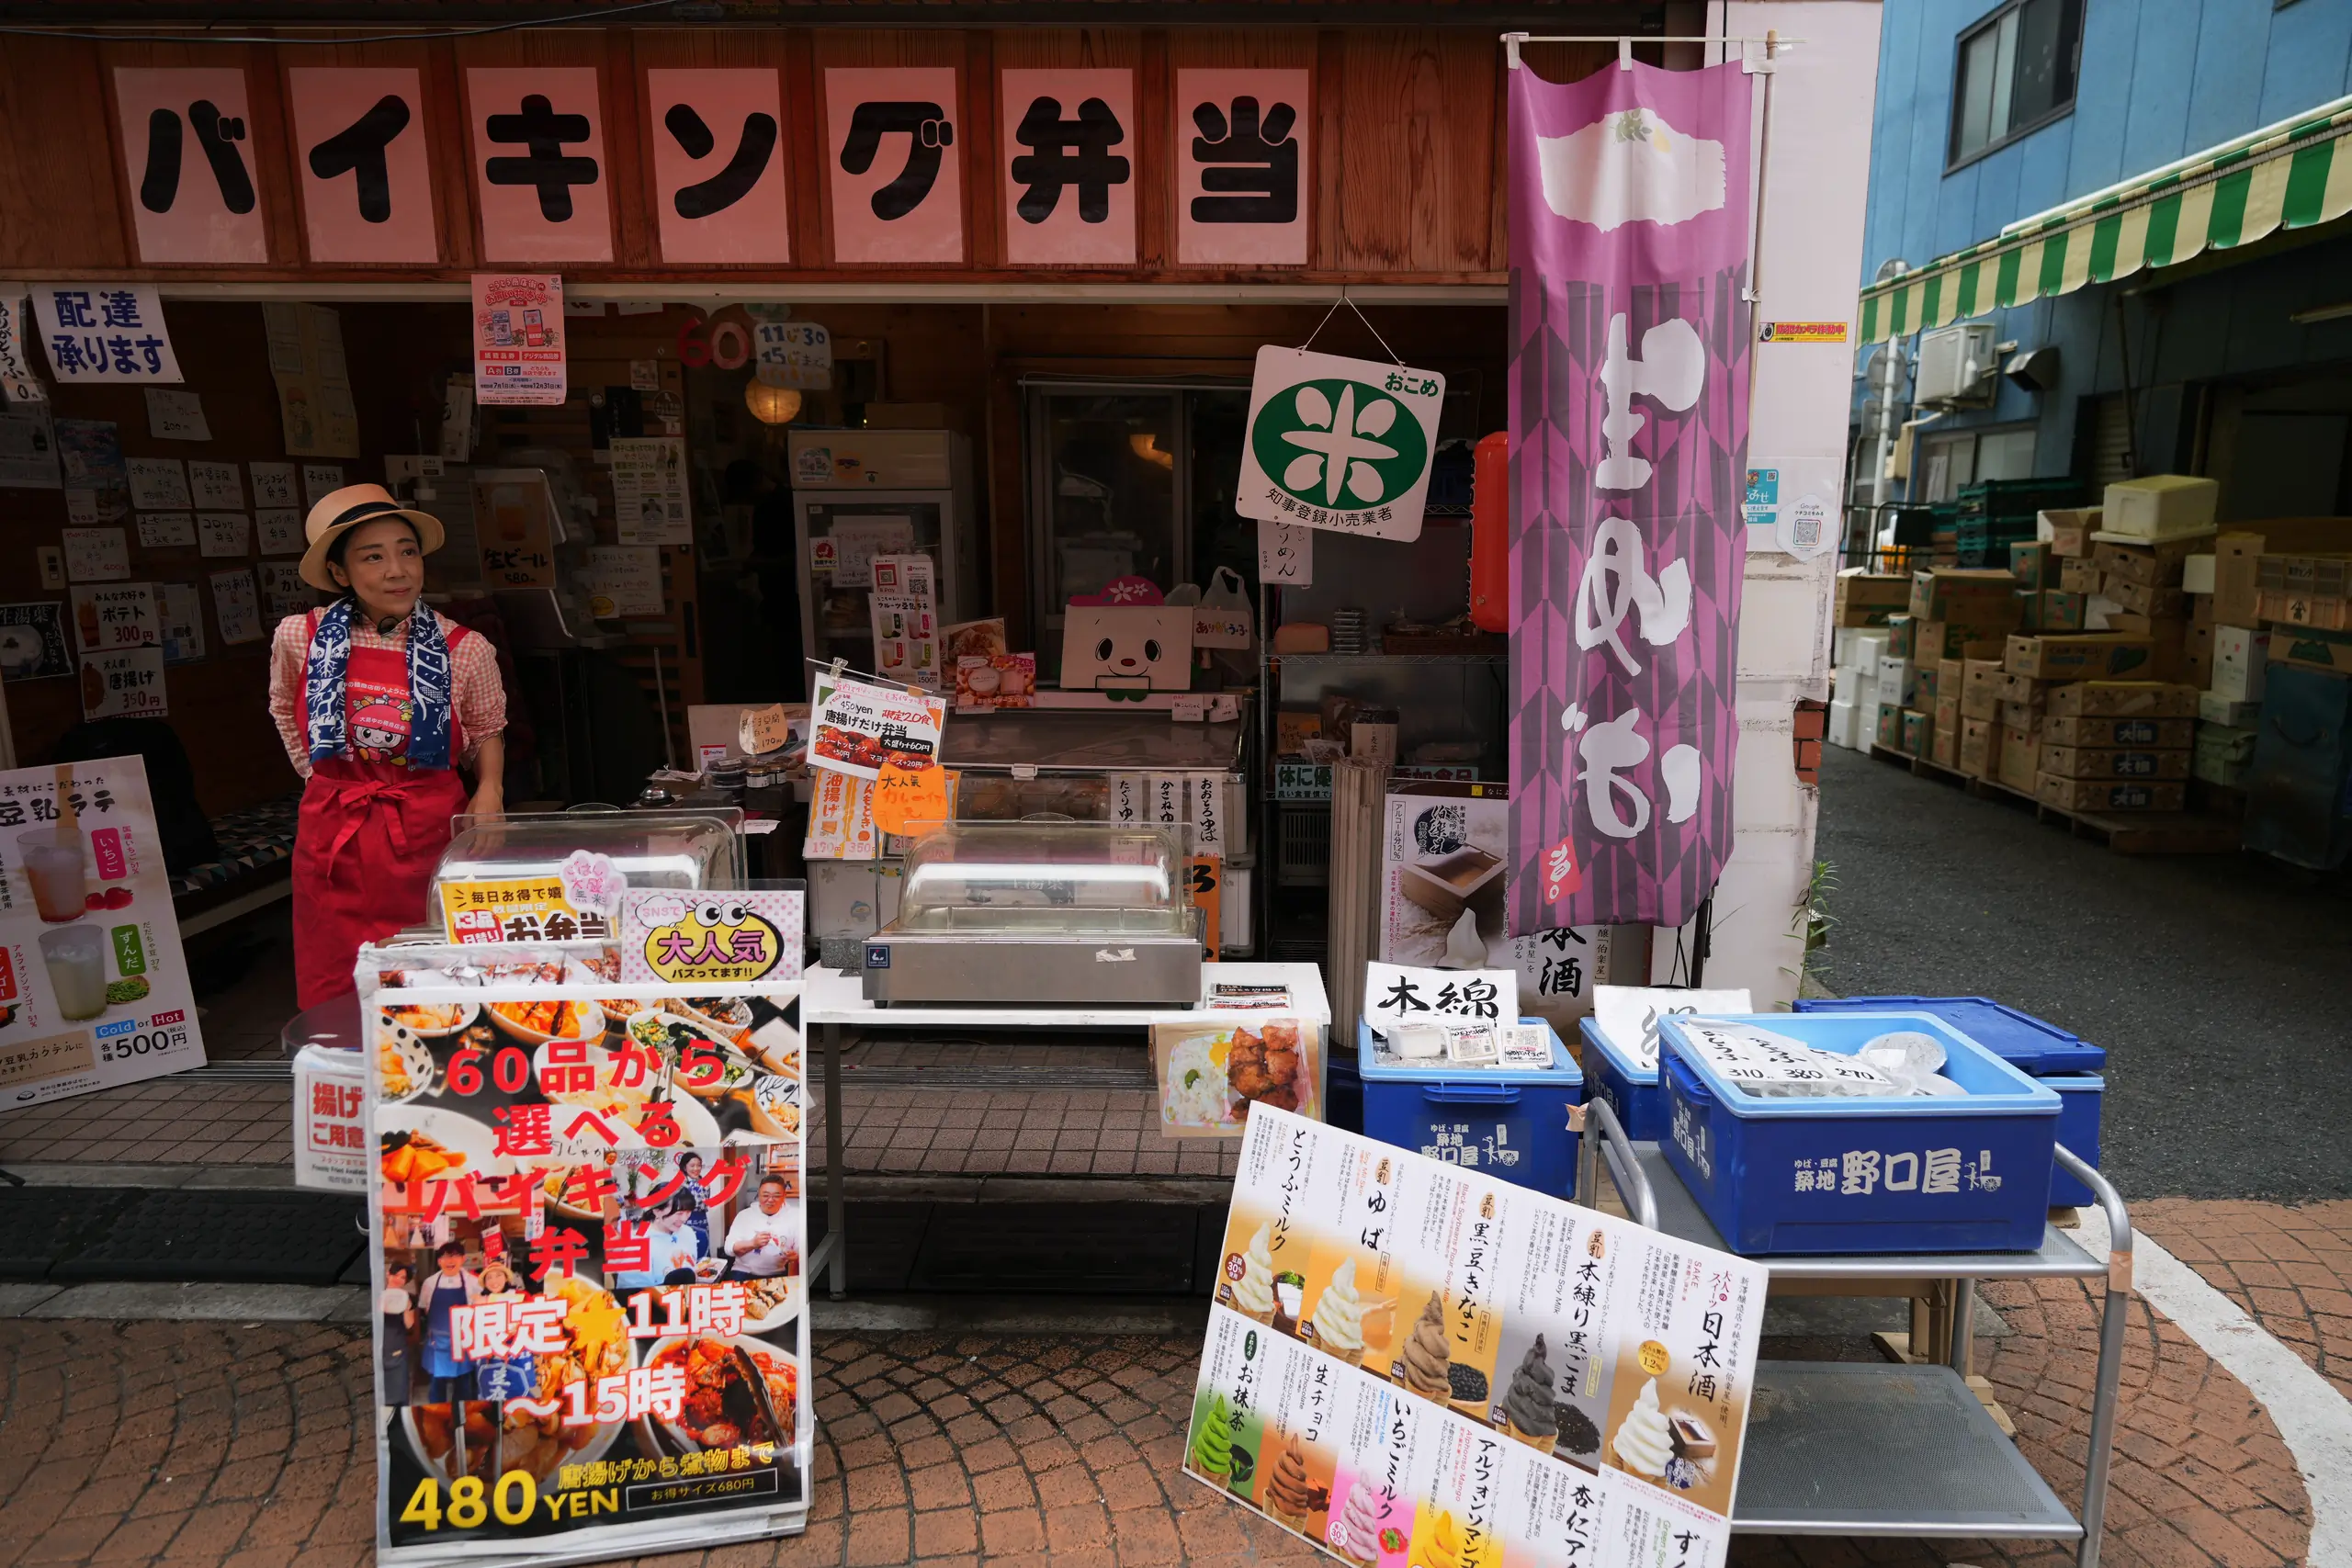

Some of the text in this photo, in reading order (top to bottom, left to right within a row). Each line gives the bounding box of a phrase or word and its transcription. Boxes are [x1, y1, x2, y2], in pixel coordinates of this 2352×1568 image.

[141, 94, 1298, 224] バイキング弁当
[53, 291, 142, 328] 配達
[1776, 324, 1845, 335] 防犯カメラ作動中
[52, 334, 164, 374] 承ります
[1385, 372, 1439, 398] おこめ
[1265, 487, 1394, 527] 知事登録小売業者
[103, 606, 145, 623] ポテト
[115, 626, 154, 643] 300円
[109, 671, 156, 689] 唐揚げ
[824, 710, 908, 737] 唐揚げだけ弁当
[819, 735, 867, 752] カレートッピング
[832, 749, 850, 758] +50円
[883, 739, 930, 751] 大盛り+60円
[870, 754, 923, 769] マヨネーズ+20円
[4, 777, 104, 797] 素材にこだわった
[823, 773, 842, 818] 油揚げ
[0, 790, 115, 827] 豆乳ラテ
[1200, 778, 1218, 842] おおとろゆば
[99, 838, 119, 873] いちご
[642, 906, 681, 918] SNSで
[119, 931, 140, 970] ずんだ
[142, 921, 157, 956] だだちゃ豆
[657, 930, 767, 965] 大人気
[672, 967, 753, 979] バズってます!!
[1377, 976, 1499, 1019] 木綿
[99, 1014, 181, 1036] Cold or Hot
[101, 1031, 187, 1062] 各種 500円
[447, 1040, 724, 1095] 60品から
[492, 1103, 682, 1157] 選べる
[1437, 1133, 1463, 1146] 築地
[1376, 1157, 1390, 1185] 豆乳
[1421, 1145, 1479, 1167] 野口屋
[1794, 1158, 1838, 1168] ゆば・豆腐
[1840, 1147, 1962, 1194] 野口屋
[423, 1156, 754, 1223] バイキング
[1270, 1125, 1307, 1258] とうふミルク
[1459, 1183, 1469, 1205] Black
[1794, 1170, 1836, 1191] 築地
[1360, 1186, 1390, 1252] ゆば
[1480, 1192, 1494, 1220] 豆乳
[1452, 1206, 1464, 1247] Soybeans
[1588, 1229, 1605, 1259] 豆乳
[529, 1219, 650, 1280] 弁当
[1231, 1255, 1242, 1266] 豆腐
[1447, 1246, 1457, 1269] Flour
[1552, 1218, 1576, 1315] Black Sesame Soy Milk
[1227, 1260, 1244, 1276] 30%
[1443, 1269, 1453, 1288] Soy
[1452, 1218, 1492, 1346] 黒豆きなこ
[1635, 1244, 1654, 1314] アイスを作りました。
[1690, 1259, 1702, 1289] SAKE
[1643, 1247, 1662, 1329] 日本酒を楽しめる大人の
[1703, 1269, 1721, 1310] スイーツ
[1718, 1269, 1732, 1303] 大人の
[450, 1282, 747, 1361] 限定 11時
[1229, 1320, 1238, 1348] Matcha
[1555, 1255, 1603, 1401] 本練り黒ごま
[1687, 1306, 1729, 1406] 日本酒
[1227, 1359, 1256, 1437] お抹茶
[1298, 1355, 1313, 1411] Raw Chocolate
[1303, 1359, 1331, 1446] 生チョコ
[558, 1441, 775, 1490] 唐揚げから煮物まで
[1374, 1396, 1412, 1528] いちごミルク
[1454, 1428, 1473, 1504] Alphonso Mango
[400, 1470, 618, 1531] 480 YEN
[650, 1477, 755, 1502] お得サイズ680円
[1555, 1472, 1568, 1523] Annin Tofu
